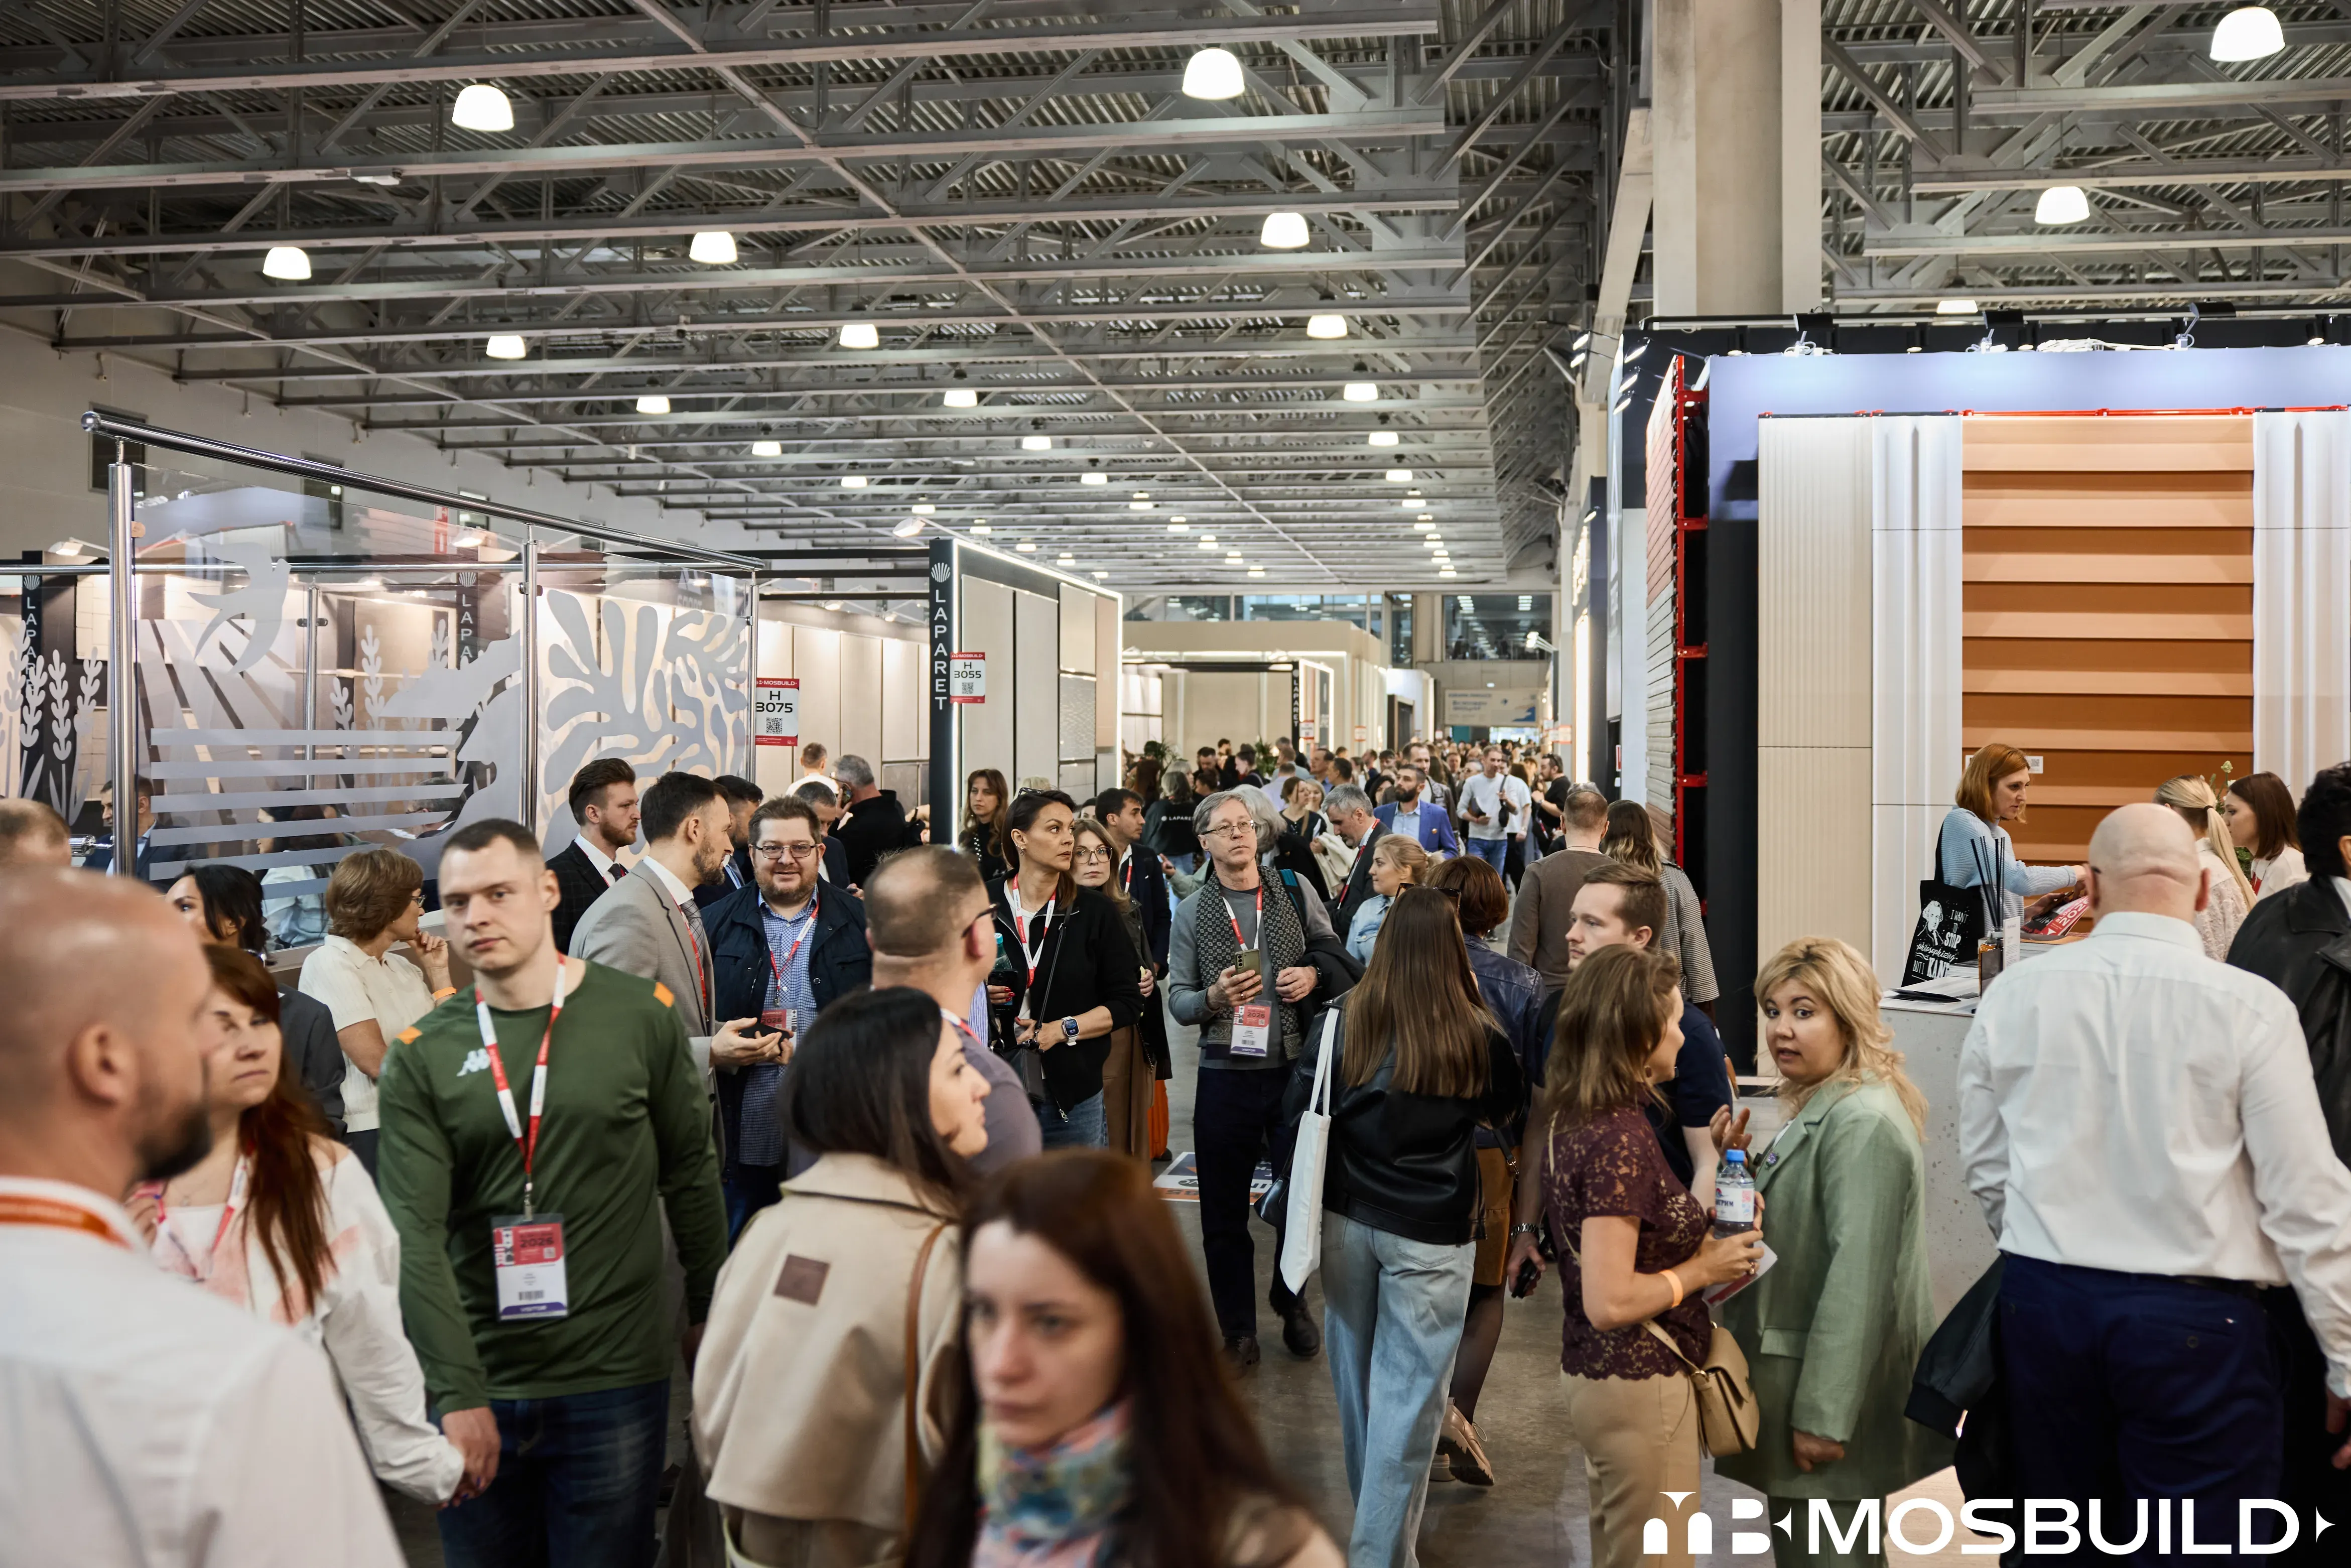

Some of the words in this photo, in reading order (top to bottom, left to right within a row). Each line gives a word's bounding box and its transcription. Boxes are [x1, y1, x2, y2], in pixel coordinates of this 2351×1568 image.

[461, 594, 473, 658] LAPA
[934, 589, 948, 710] LAPARET
[769, 690, 780, 701] H
[1950, 909, 1955, 920] I
[1954, 911, 1969, 924] WANT
[1952, 923, 1958, 933] TO
[1944, 932, 1962, 949] STOP
[1916, 942, 1956, 963] philosophizing
[1913, 960, 1922, 973] BUT
[1921, 963, 1925, 975] I
